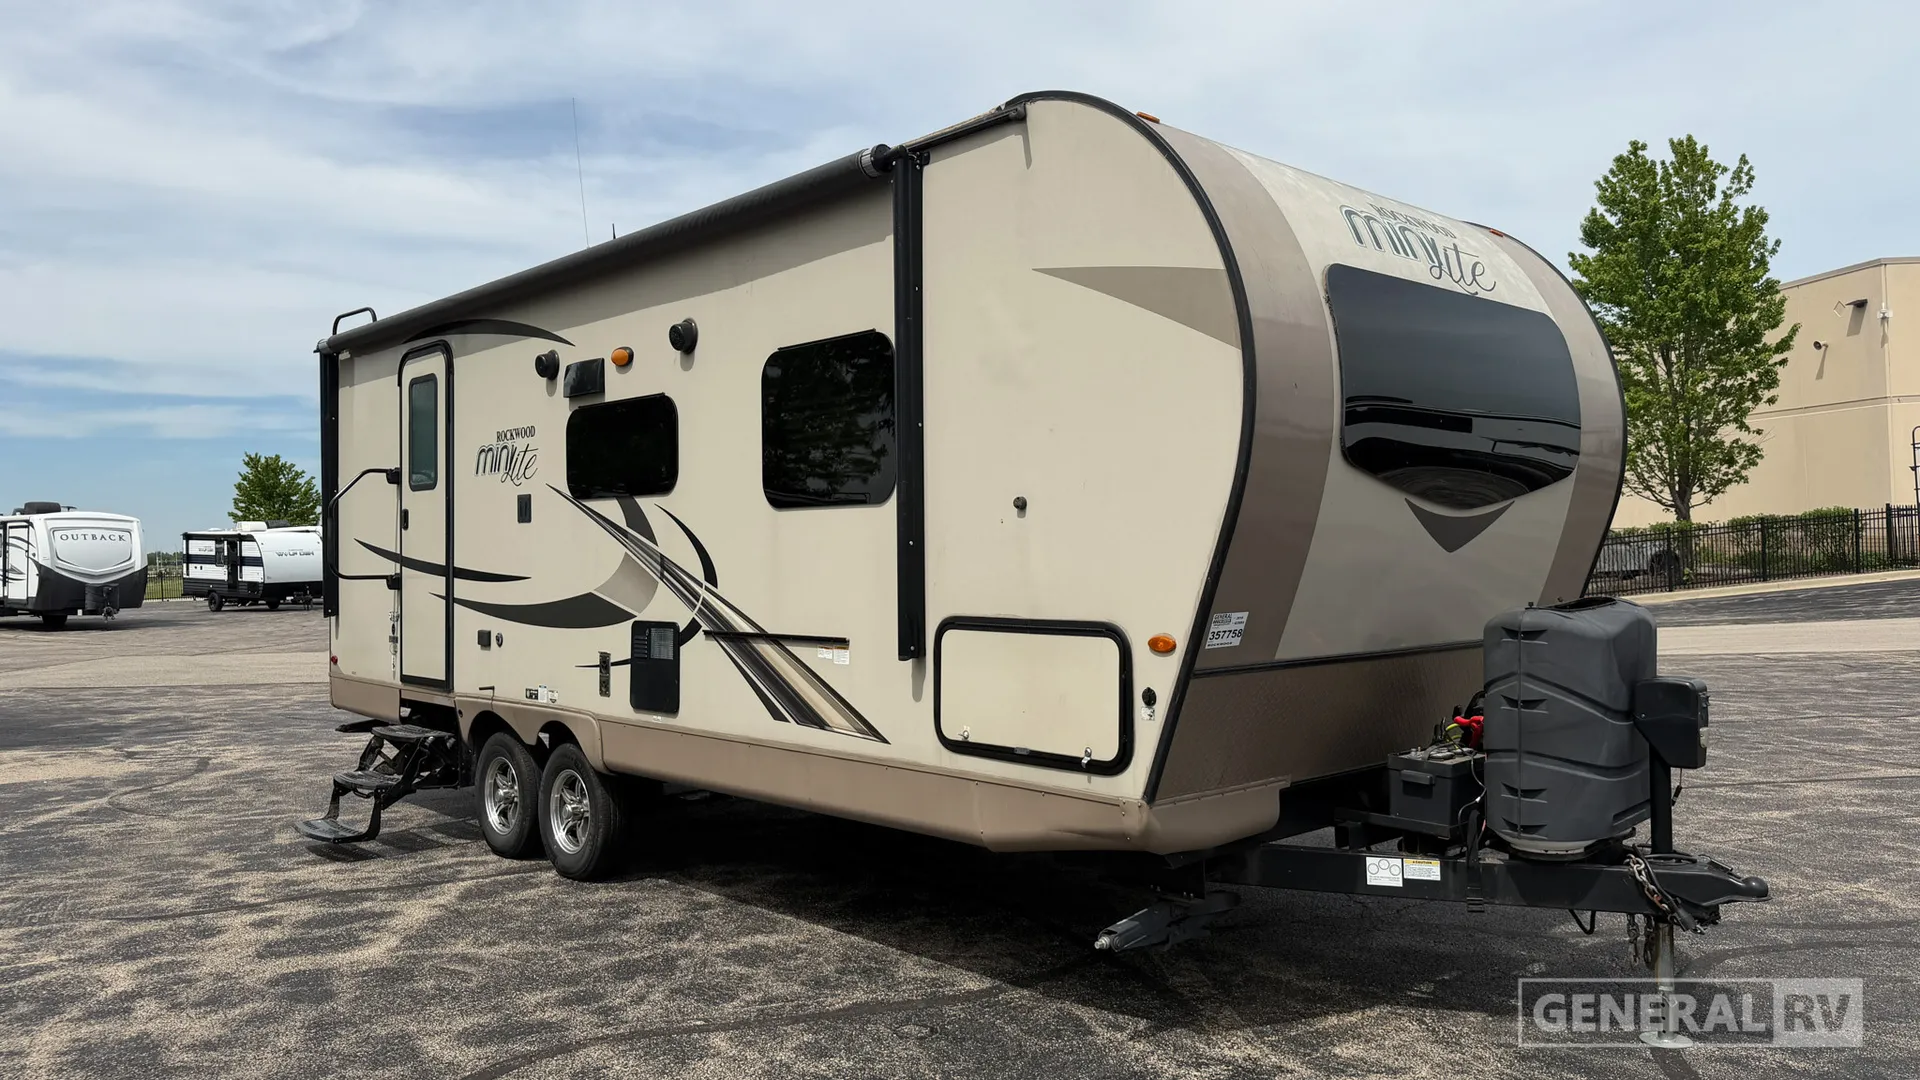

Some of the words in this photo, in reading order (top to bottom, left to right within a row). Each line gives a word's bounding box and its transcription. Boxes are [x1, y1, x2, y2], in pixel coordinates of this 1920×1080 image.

[1369, 203, 1457, 239] ROCKWOOD
[496, 425, 536, 443] ROCKWOOD
[60, 534, 126, 542] OUTBACK
[1209, 628, 1243, 641] 357758
